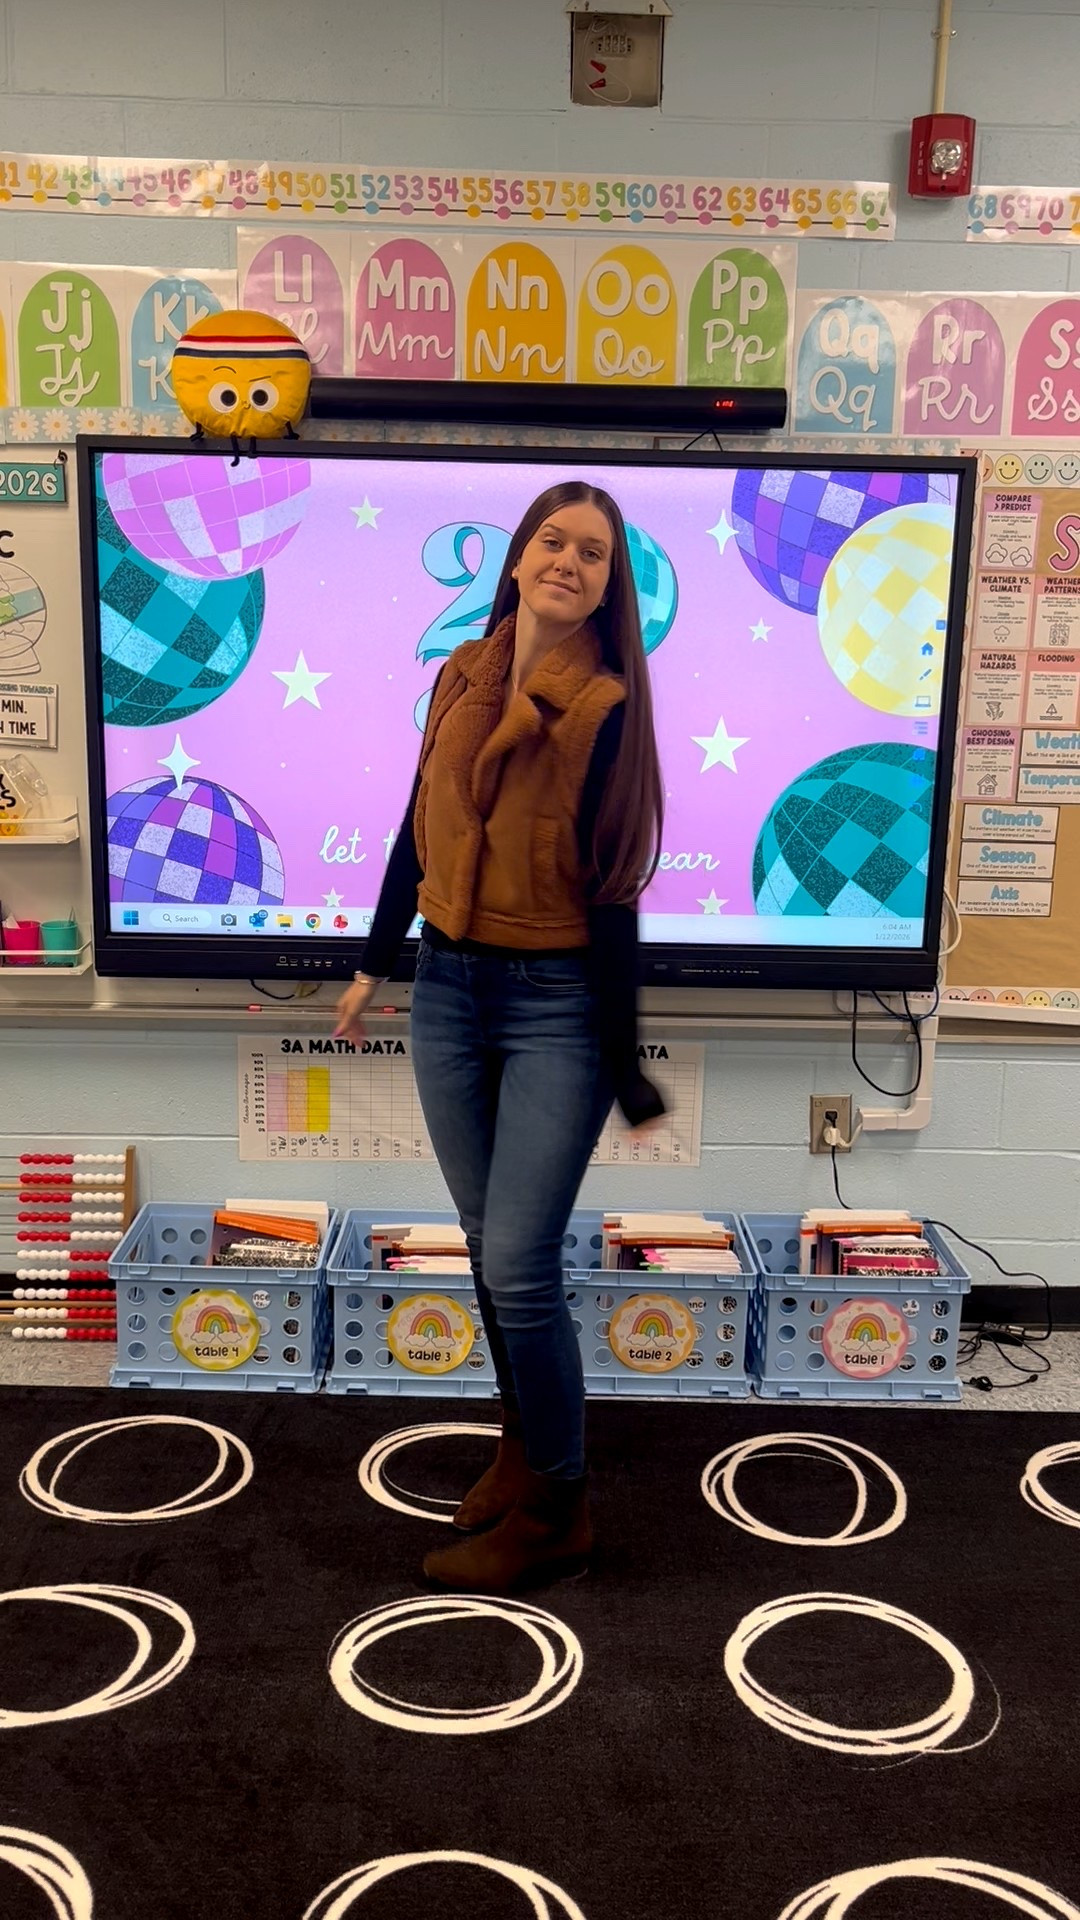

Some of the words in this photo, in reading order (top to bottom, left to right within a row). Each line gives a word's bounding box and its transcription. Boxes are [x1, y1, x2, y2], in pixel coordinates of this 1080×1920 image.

[27, 163, 58, 190] 42
[62, 164, 92, 191] 43
[127, 167, 158, 192] 45
[161, 168, 191, 193] 46
[229, 169, 259, 195] 48
[263, 171, 293, 196] 49
[296, 172, 326, 198] 50
[330, 173, 357, 199] 51
[362, 174, 391, 200] 52
[394, 175, 424, 201] 53
[428, 176, 459, 203] 54
[462, 177, 493, 203] 55
[494, 179, 524, 205] 56
[527, 180, 556, 206] 57
[561, 181, 591, 207] 58
[596, 182, 626, 208] 59
[627, 183, 657, 208] 60
[659, 183, 686, 209] 61
[693, 185, 722, 211] 62
[726, 185, 757, 212] 63
[759, 187, 790, 213] 64
[792, 188, 822, 214] 65
[826, 189, 858, 215] 66
[861, 191, 890, 216] 67
[968, 194, 998, 219] 68
[1001, 194, 1031, 219] 69
[1037, 195, 1064, 221] 70
[1069, 195, 1080, 221] 7
[368, 258, 449, 311] Mm
[488, 258, 548, 310] Nn
[588, 260, 670, 316] Oo
[712, 259, 768, 325] Pp
[42, 281, 93, 352] Jj
[358, 321, 454, 362] Mm
[819, 308, 879, 374] Qq
[933, 314, 986, 365] Rr
[474, 326, 564, 377] Nn
[594, 328, 664, 378] Oo
[703, 318, 775, 382] Pp
[36, 343, 100, 407] Jj
[138, 356, 177, 401] K
[810, 366, 876, 432] Qq
[918, 376, 994, 425] Rr
[995, 494, 1031, 502] COMPARE
[1001, 503, 1031, 511] PREDICT
[981, 576, 1017, 584] WEATHER
[1019, 577, 1031, 585] VS.
[990, 585, 1022, 593] CLIMATE
[1046, 577, 1080, 585] WEATHER
[980, 662, 1016, 670] HAZARDS
[981, 653, 1016, 661] NATURAL
[1038, 654, 1075, 662] FLOODING
[1, 700, 28, 714] MIN.
[9, 721, 37, 735] TIME
[971, 729, 1011, 737] CHOOSING
[966, 737, 986, 745] BEST
[1035, 731, 1080, 749] Weat
[1022, 770, 1080, 789] Tempera
[982, 808, 1043, 826] Climate
[319, 825, 366, 863] let
[659, 852, 720, 870] ear
[980, 845, 1036, 864] Season
[990, 885, 1020, 900] Axis
[175, 914, 198, 923] Search
[281, 1039, 303, 1054] 3A
[309, 1039, 356, 1054] MATH
[362, 1040, 406, 1055] DATA
[638, 1045, 669, 1059] ATA
[194, 1346, 226, 1357] table
[228, 1347, 239, 1357] 4
[408, 1349, 441, 1361] table
[444, 1351, 451, 1362] 3
[629, 1348, 662, 1360] table
[665, 1350, 672, 1361] 2
[845, 1354, 878, 1365] table
